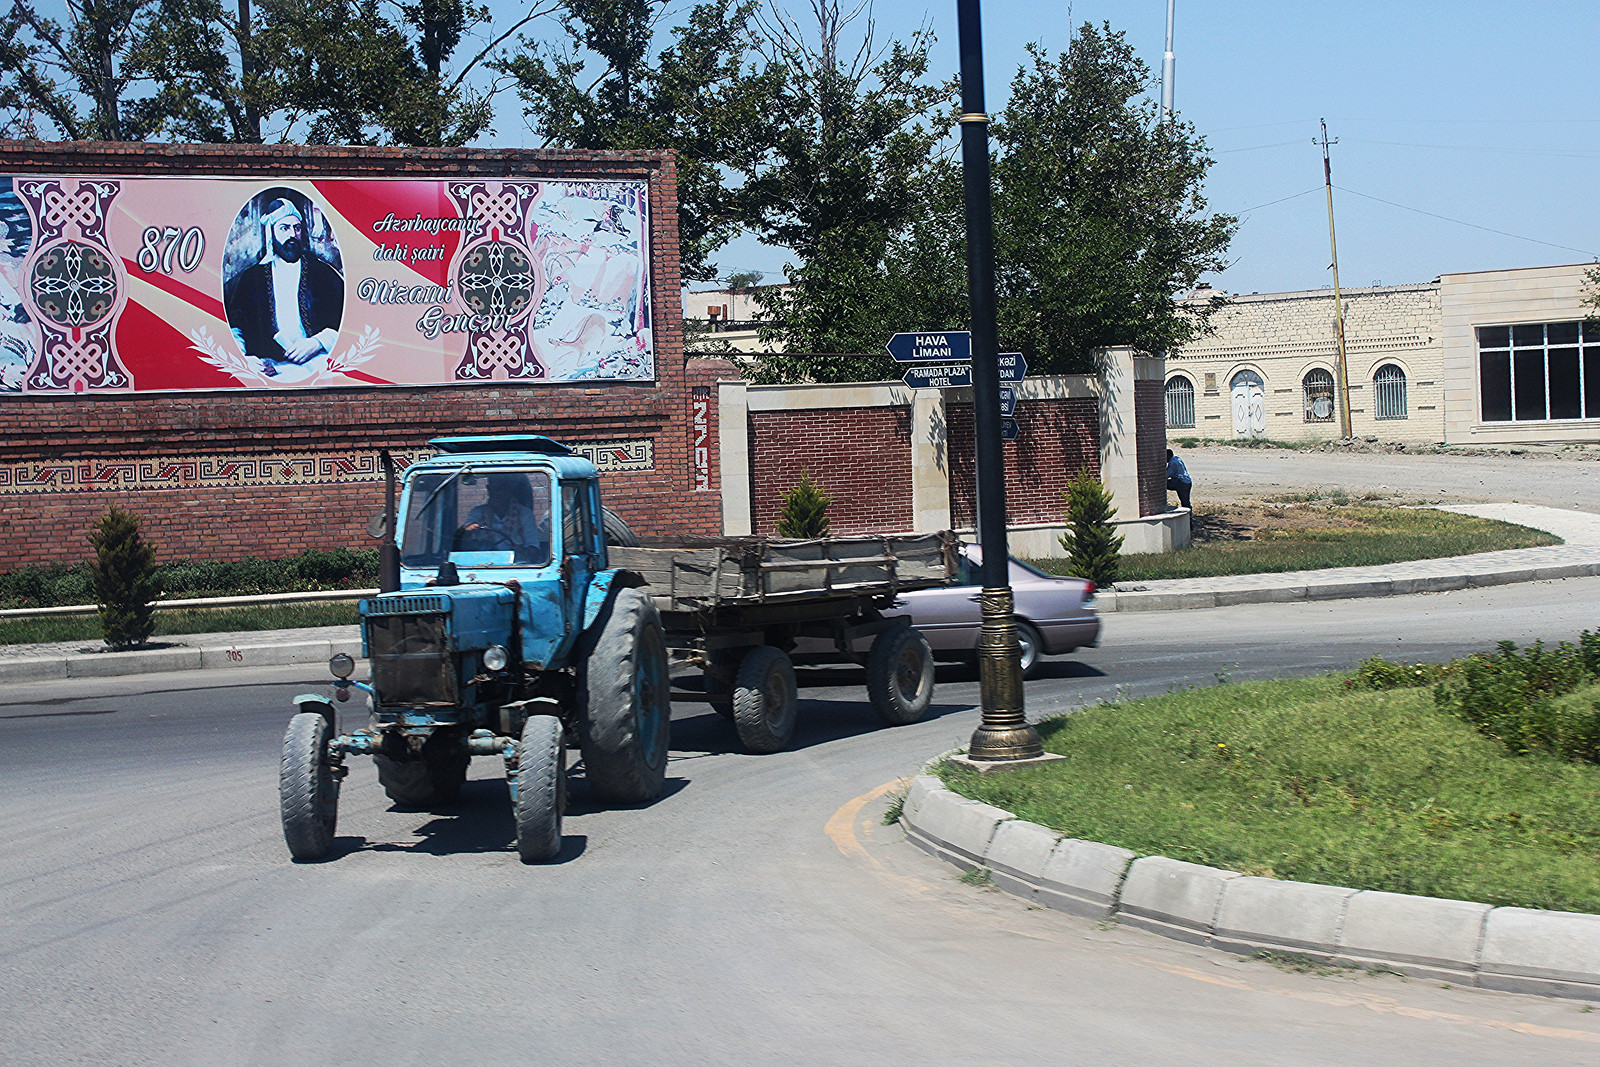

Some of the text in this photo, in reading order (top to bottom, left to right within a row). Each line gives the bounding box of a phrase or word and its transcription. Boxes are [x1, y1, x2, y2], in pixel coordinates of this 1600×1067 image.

[137, 226, 205, 274] 870
[373, 243, 446, 265] dahi şairi
[357, 277, 454, 305] Nizami
[915, 335, 948, 346] HAVA
[912, 347, 952, 357] LİMANI
[998, 355, 1016, 367] KƏZİ
[998, 369, 1015, 378] DAN
[929, 377, 952, 387] HOTEL
